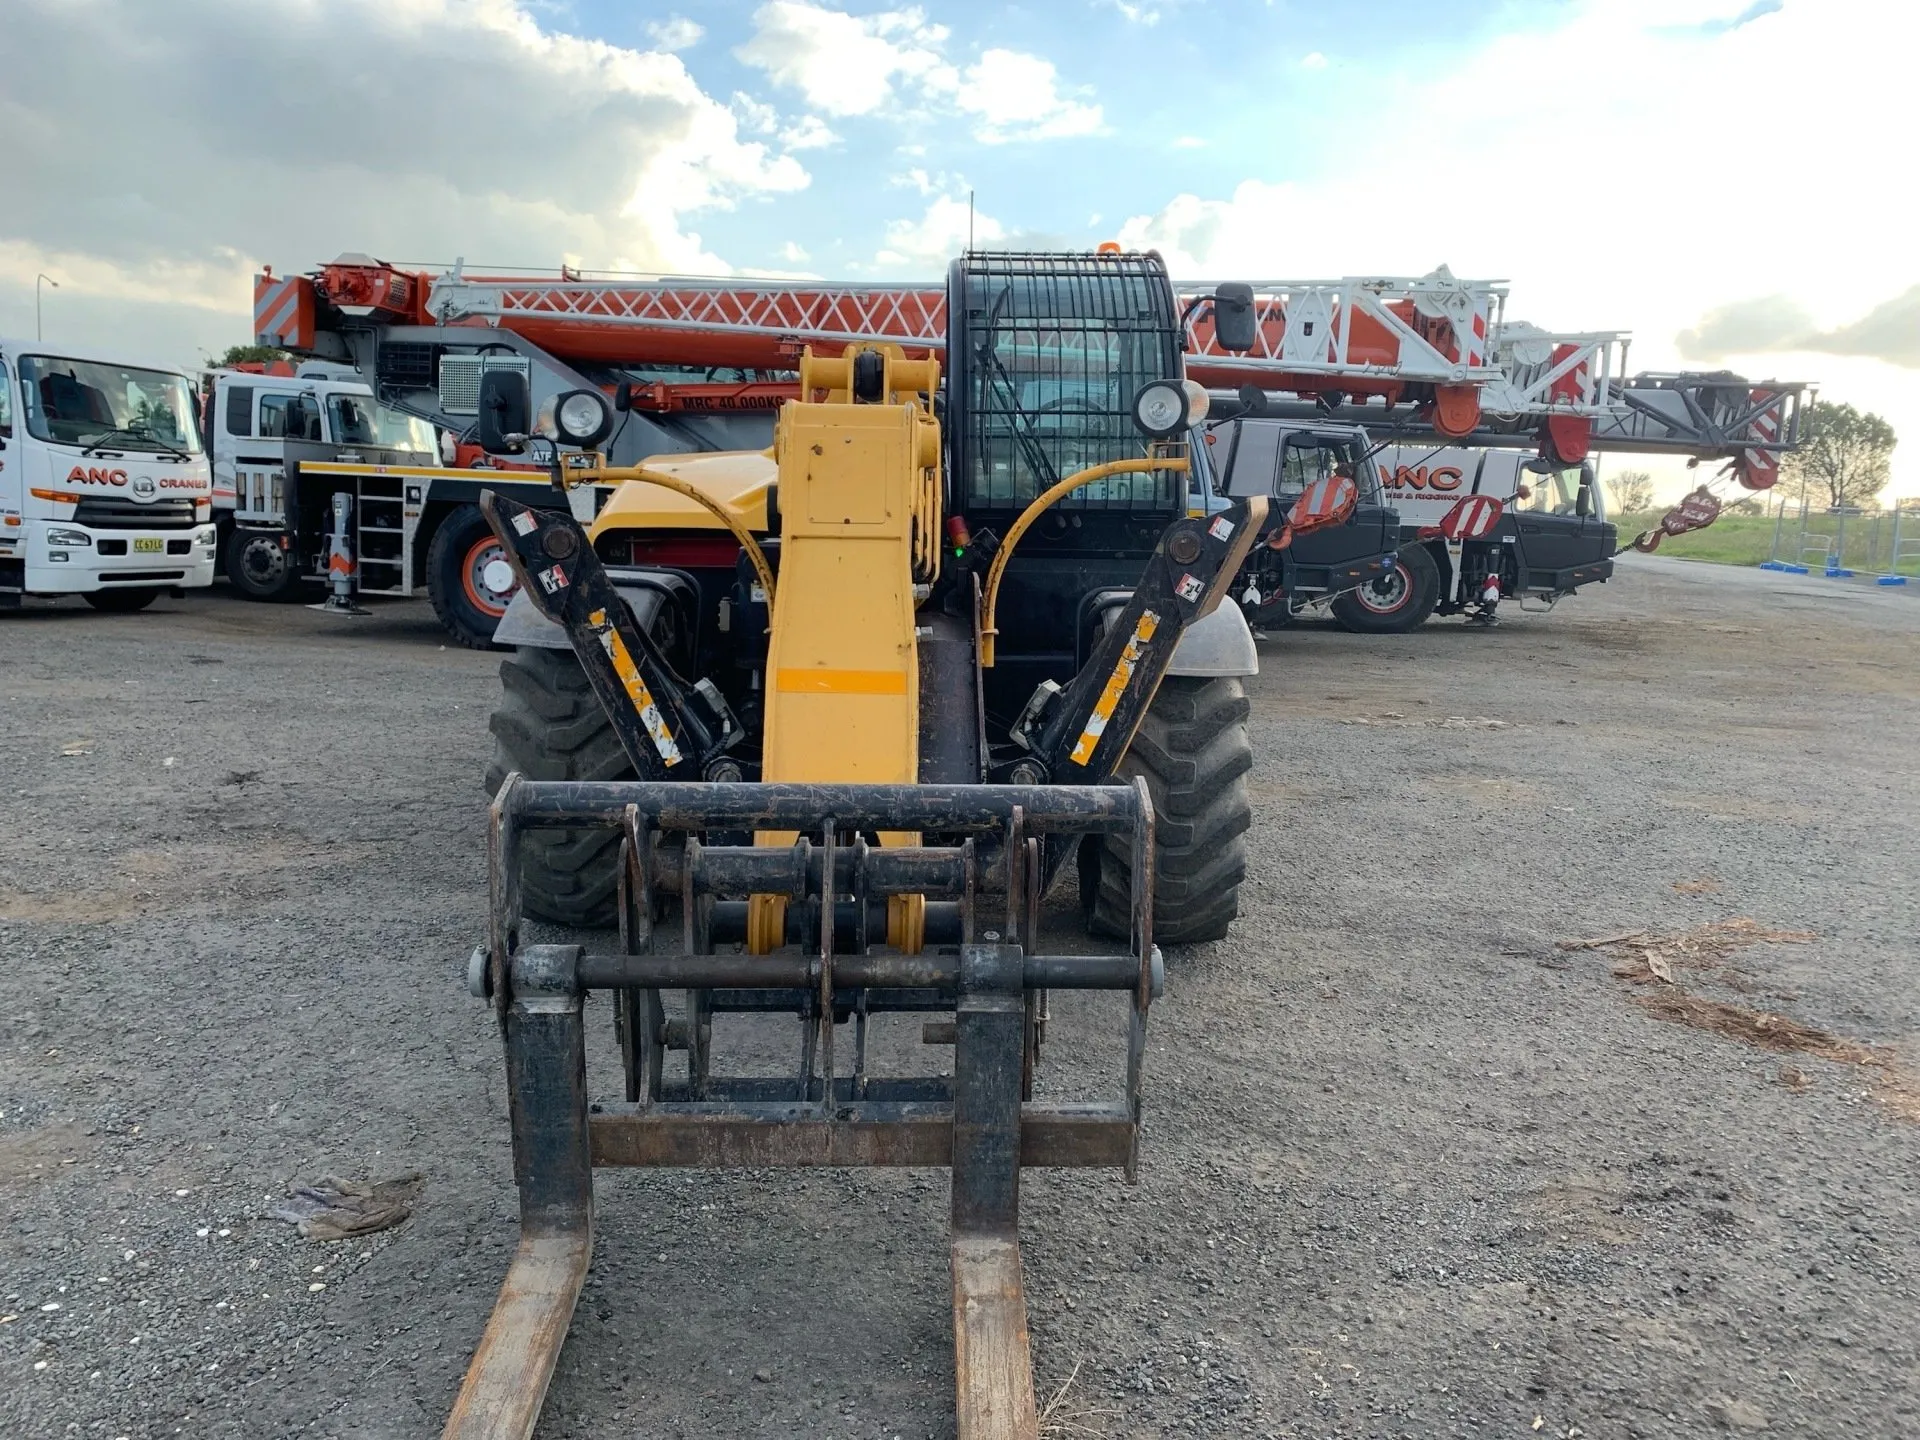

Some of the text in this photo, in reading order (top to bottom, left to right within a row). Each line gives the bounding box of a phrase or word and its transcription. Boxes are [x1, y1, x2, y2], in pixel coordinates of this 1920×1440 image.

[533, 450, 552, 462] ATF
[67, 466, 208, 489] ANC CRANES
